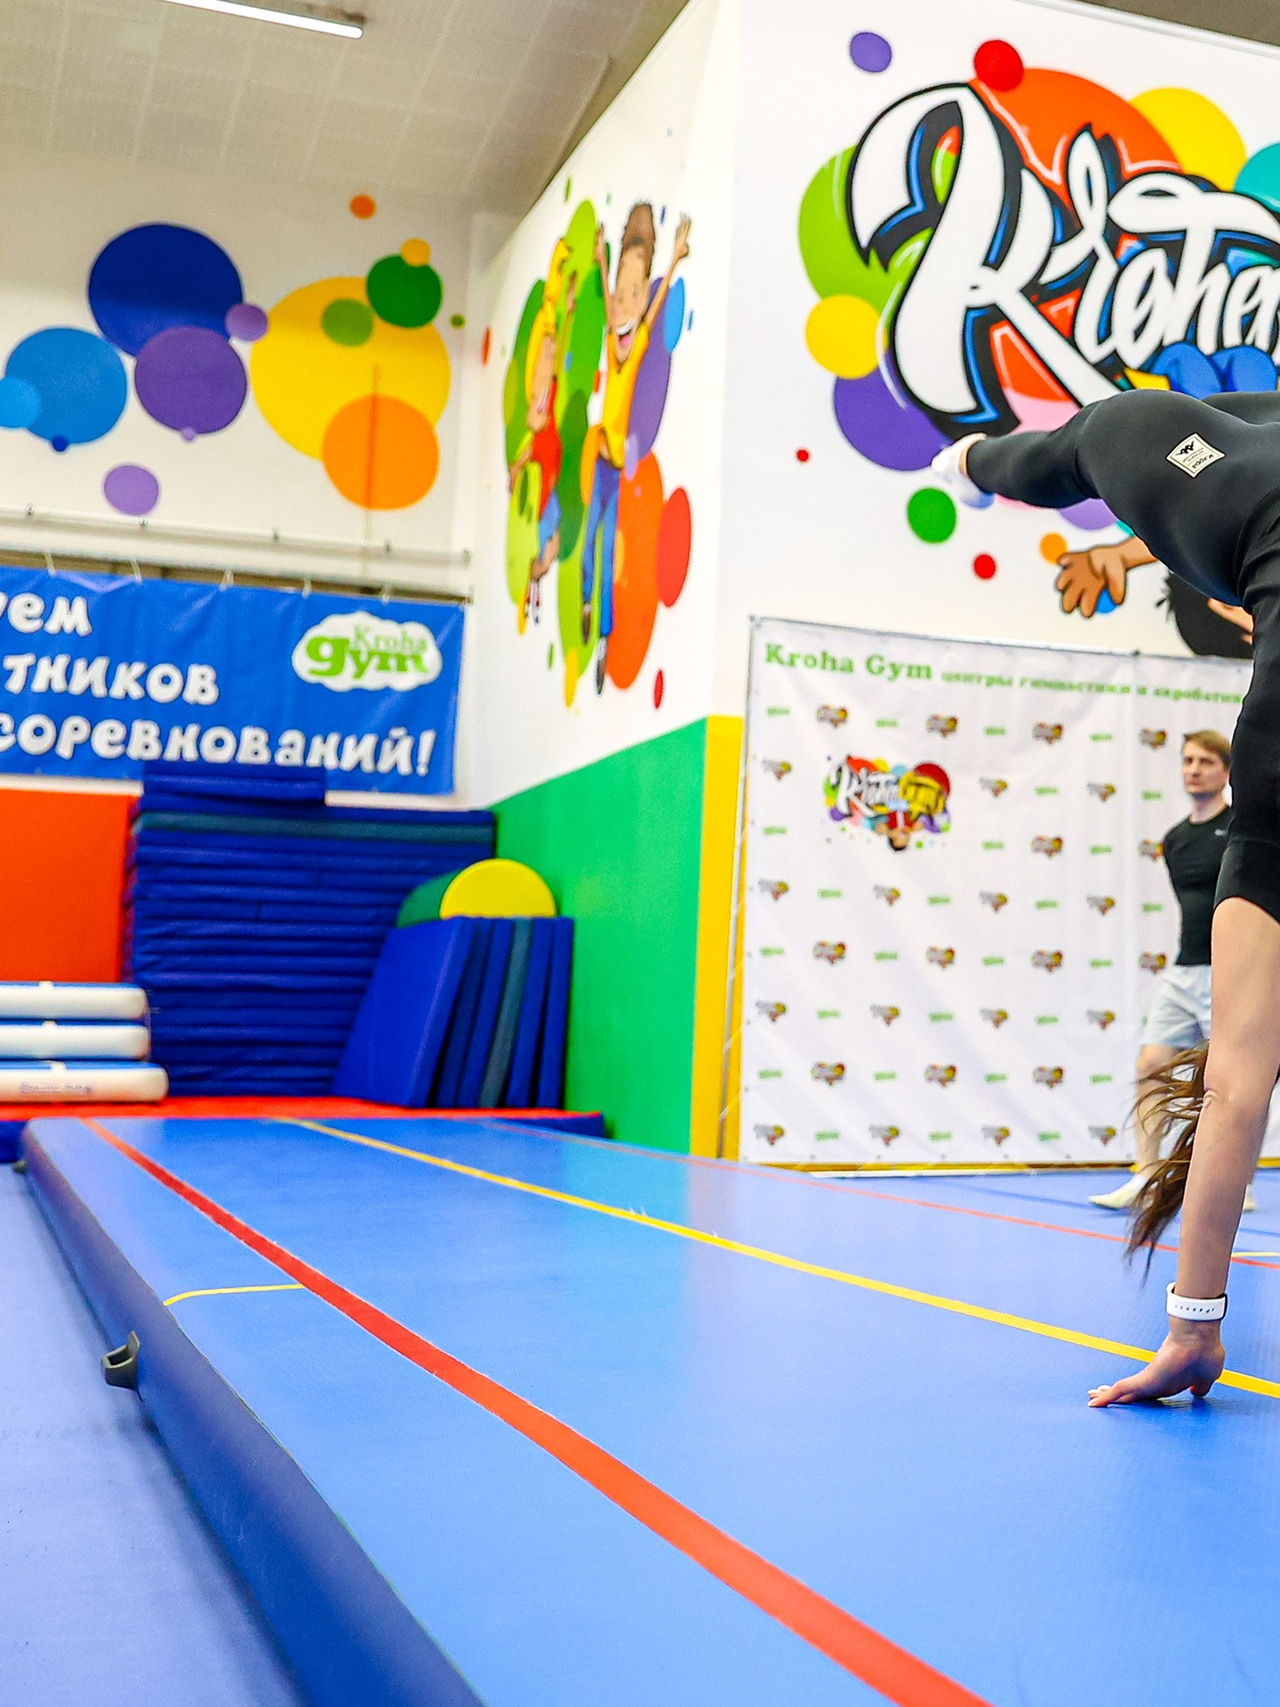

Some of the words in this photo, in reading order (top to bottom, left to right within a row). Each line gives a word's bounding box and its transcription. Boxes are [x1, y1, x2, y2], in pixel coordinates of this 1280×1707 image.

[0, 591, 93, 637] ем
[306, 635, 428, 681] gym
[354, 624, 428, 654] Kroha
[2, 652, 219, 706] тников
[765, 643, 854, 673] Kroha
[865, 654, 933, 682] Gym
